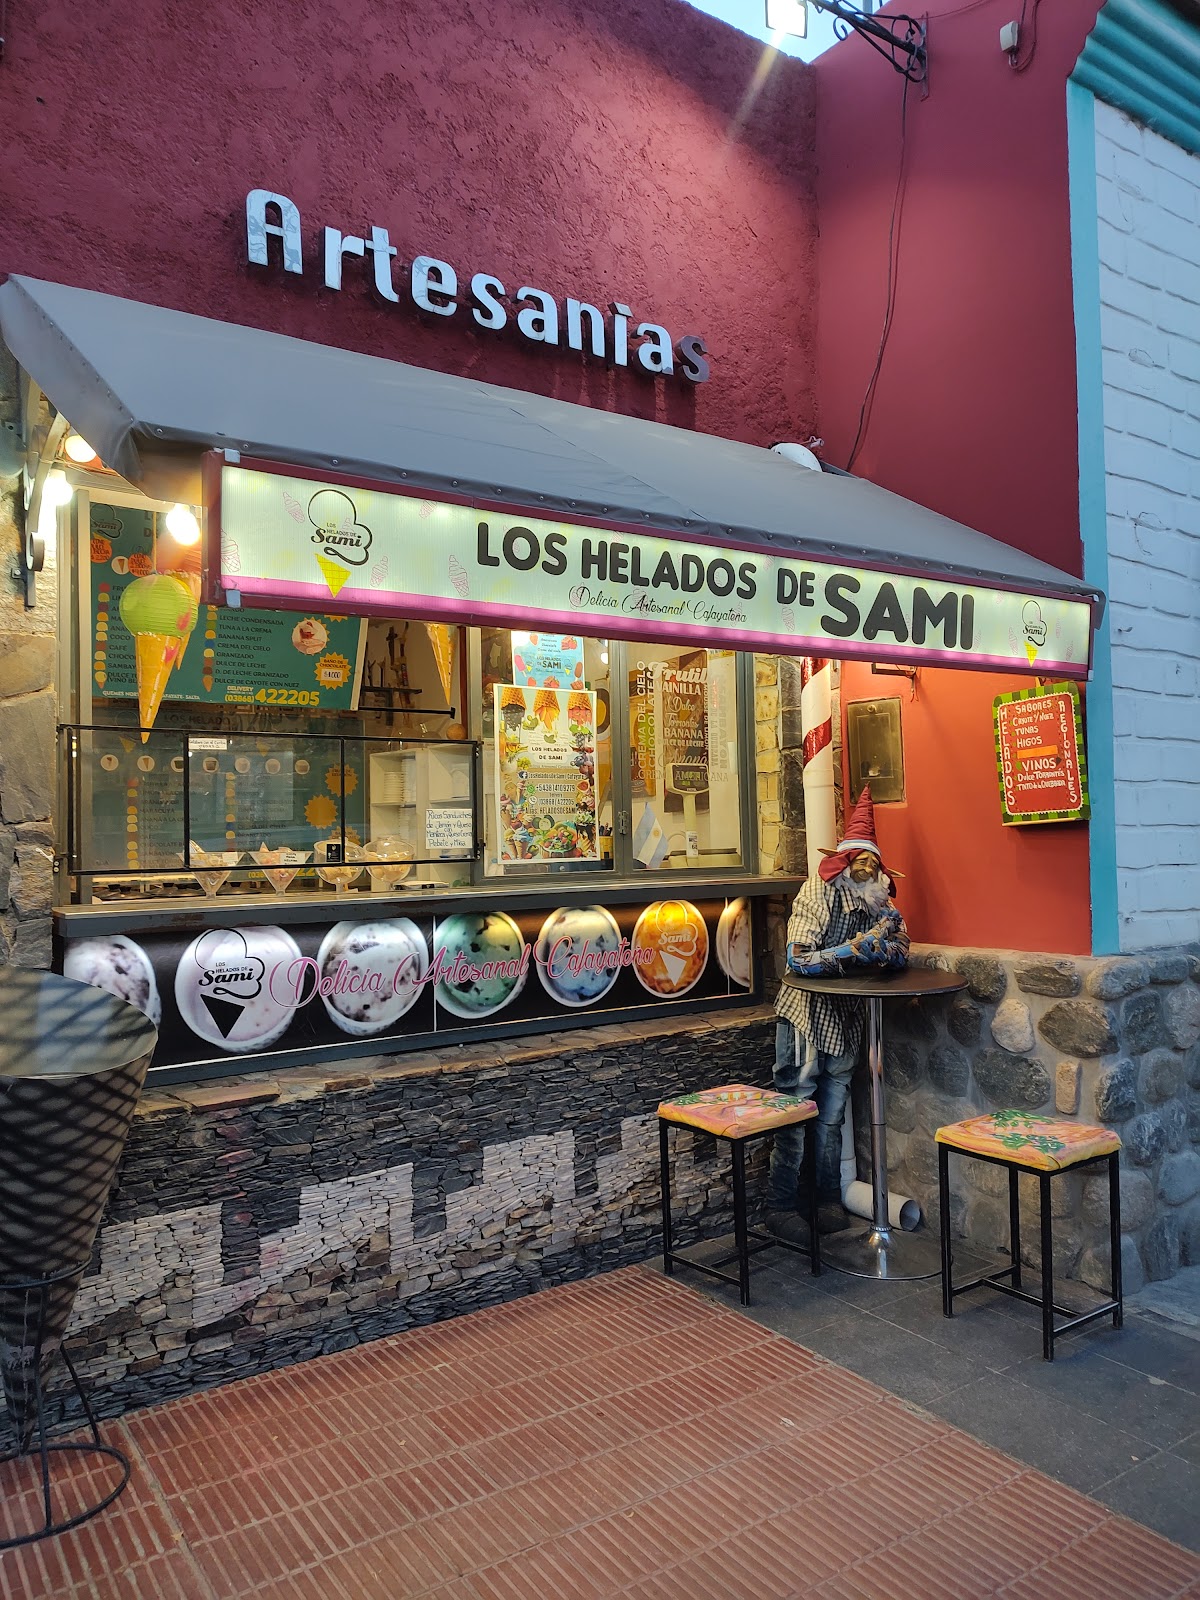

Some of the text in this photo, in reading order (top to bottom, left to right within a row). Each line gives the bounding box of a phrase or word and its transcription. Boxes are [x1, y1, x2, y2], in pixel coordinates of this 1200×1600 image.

[310, 528, 362, 547] Sami
[477, 522, 975, 650] LOS HELADOS DE SAMI
[621, 590, 686, 616] Artesanal
[241, 617, 284, 626] CONDENSADA
[1022, 625, 1043, 635] Sami
[217, 651, 254, 659] GRANIZADO
[542, 660, 562, 669] SAMI
[253, 671, 289, 679] GRANIZADO
[255, 688, 320, 706] 422205
[1015, 699, 1052, 714] SABORES
[636, 660, 647, 769] CREMA DEL CIELO
[664, 727, 704, 739] BANANA
[1015, 725, 1039, 736] TUNAS
[1016, 736, 1043, 748] HIGOS
[1000, 707, 1016, 806] HELADOS
[1058, 700, 1078, 803] REGIONALES
[1021, 757, 1057, 772] VINOS
[658, 930, 693, 945] Sami
[198, 968, 254, 986] Sami
[268, 956, 386, 1009] Delicia
[393, 942, 531, 997] Artesanal
